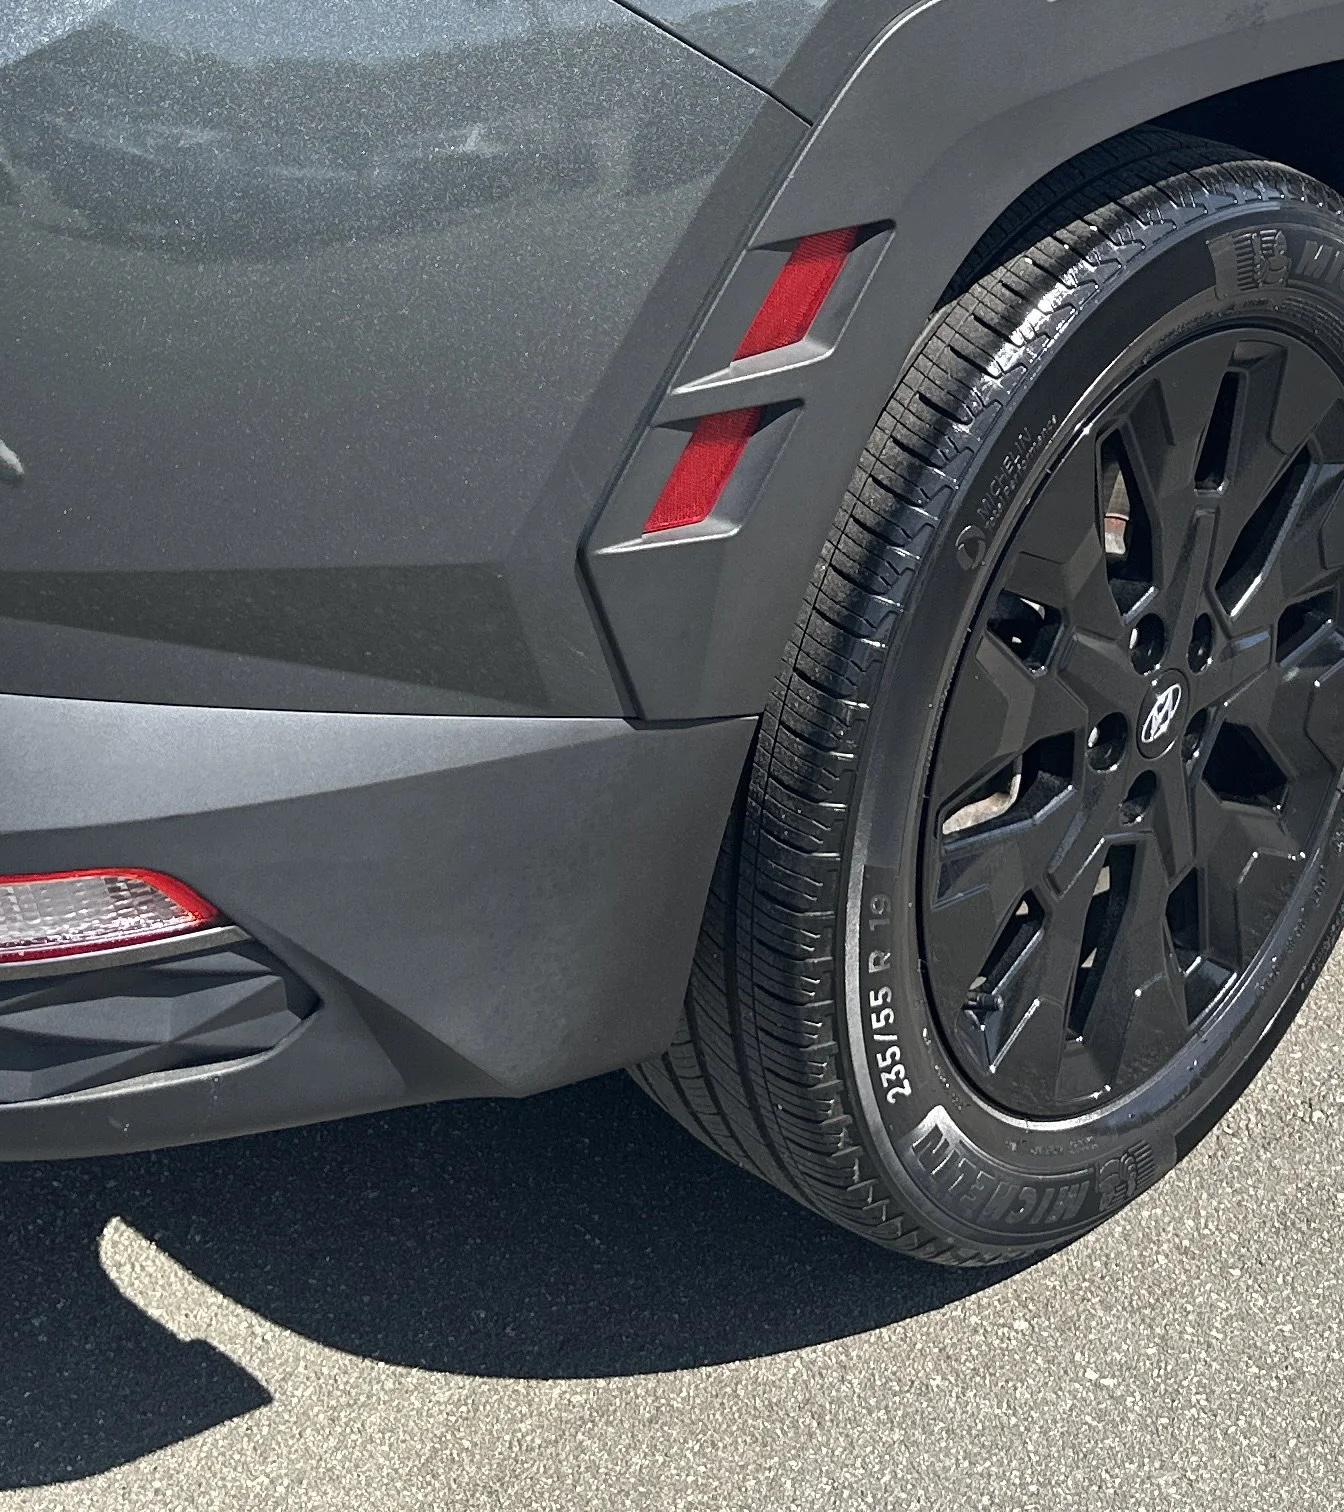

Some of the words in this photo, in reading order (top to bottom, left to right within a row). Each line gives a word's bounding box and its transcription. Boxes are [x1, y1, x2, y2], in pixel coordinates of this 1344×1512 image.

[976, 426, 1032, 522] MICHELIN
[868, 893, 892, 932] 19
[868, 949, 892, 974] R
[869, 986, 912, 1105] 235/55
[908, 1124, 1090, 1224] MICHELIN
